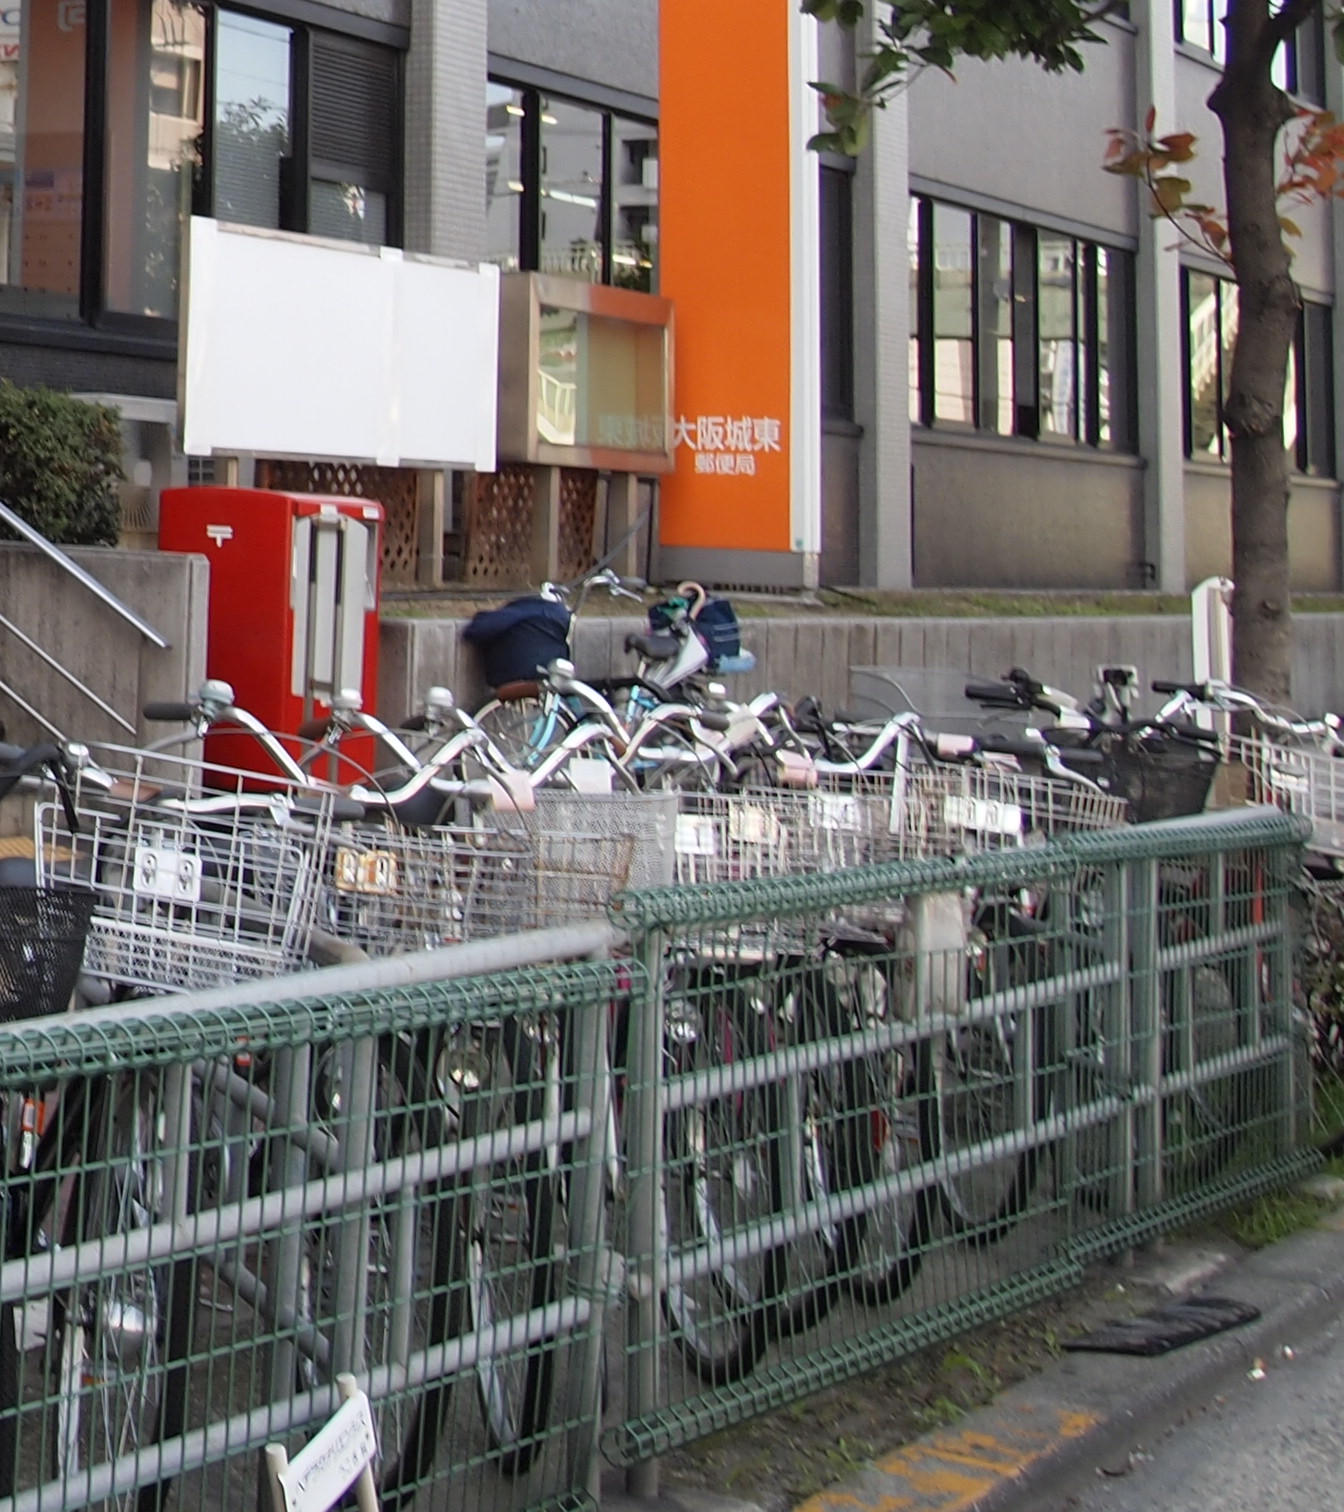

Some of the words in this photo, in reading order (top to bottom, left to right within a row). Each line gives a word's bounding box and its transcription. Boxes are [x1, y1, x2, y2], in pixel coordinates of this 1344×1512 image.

[672, 414, 782, 453] 大阪城東
[694, 452, 756, 476] 郵便局
